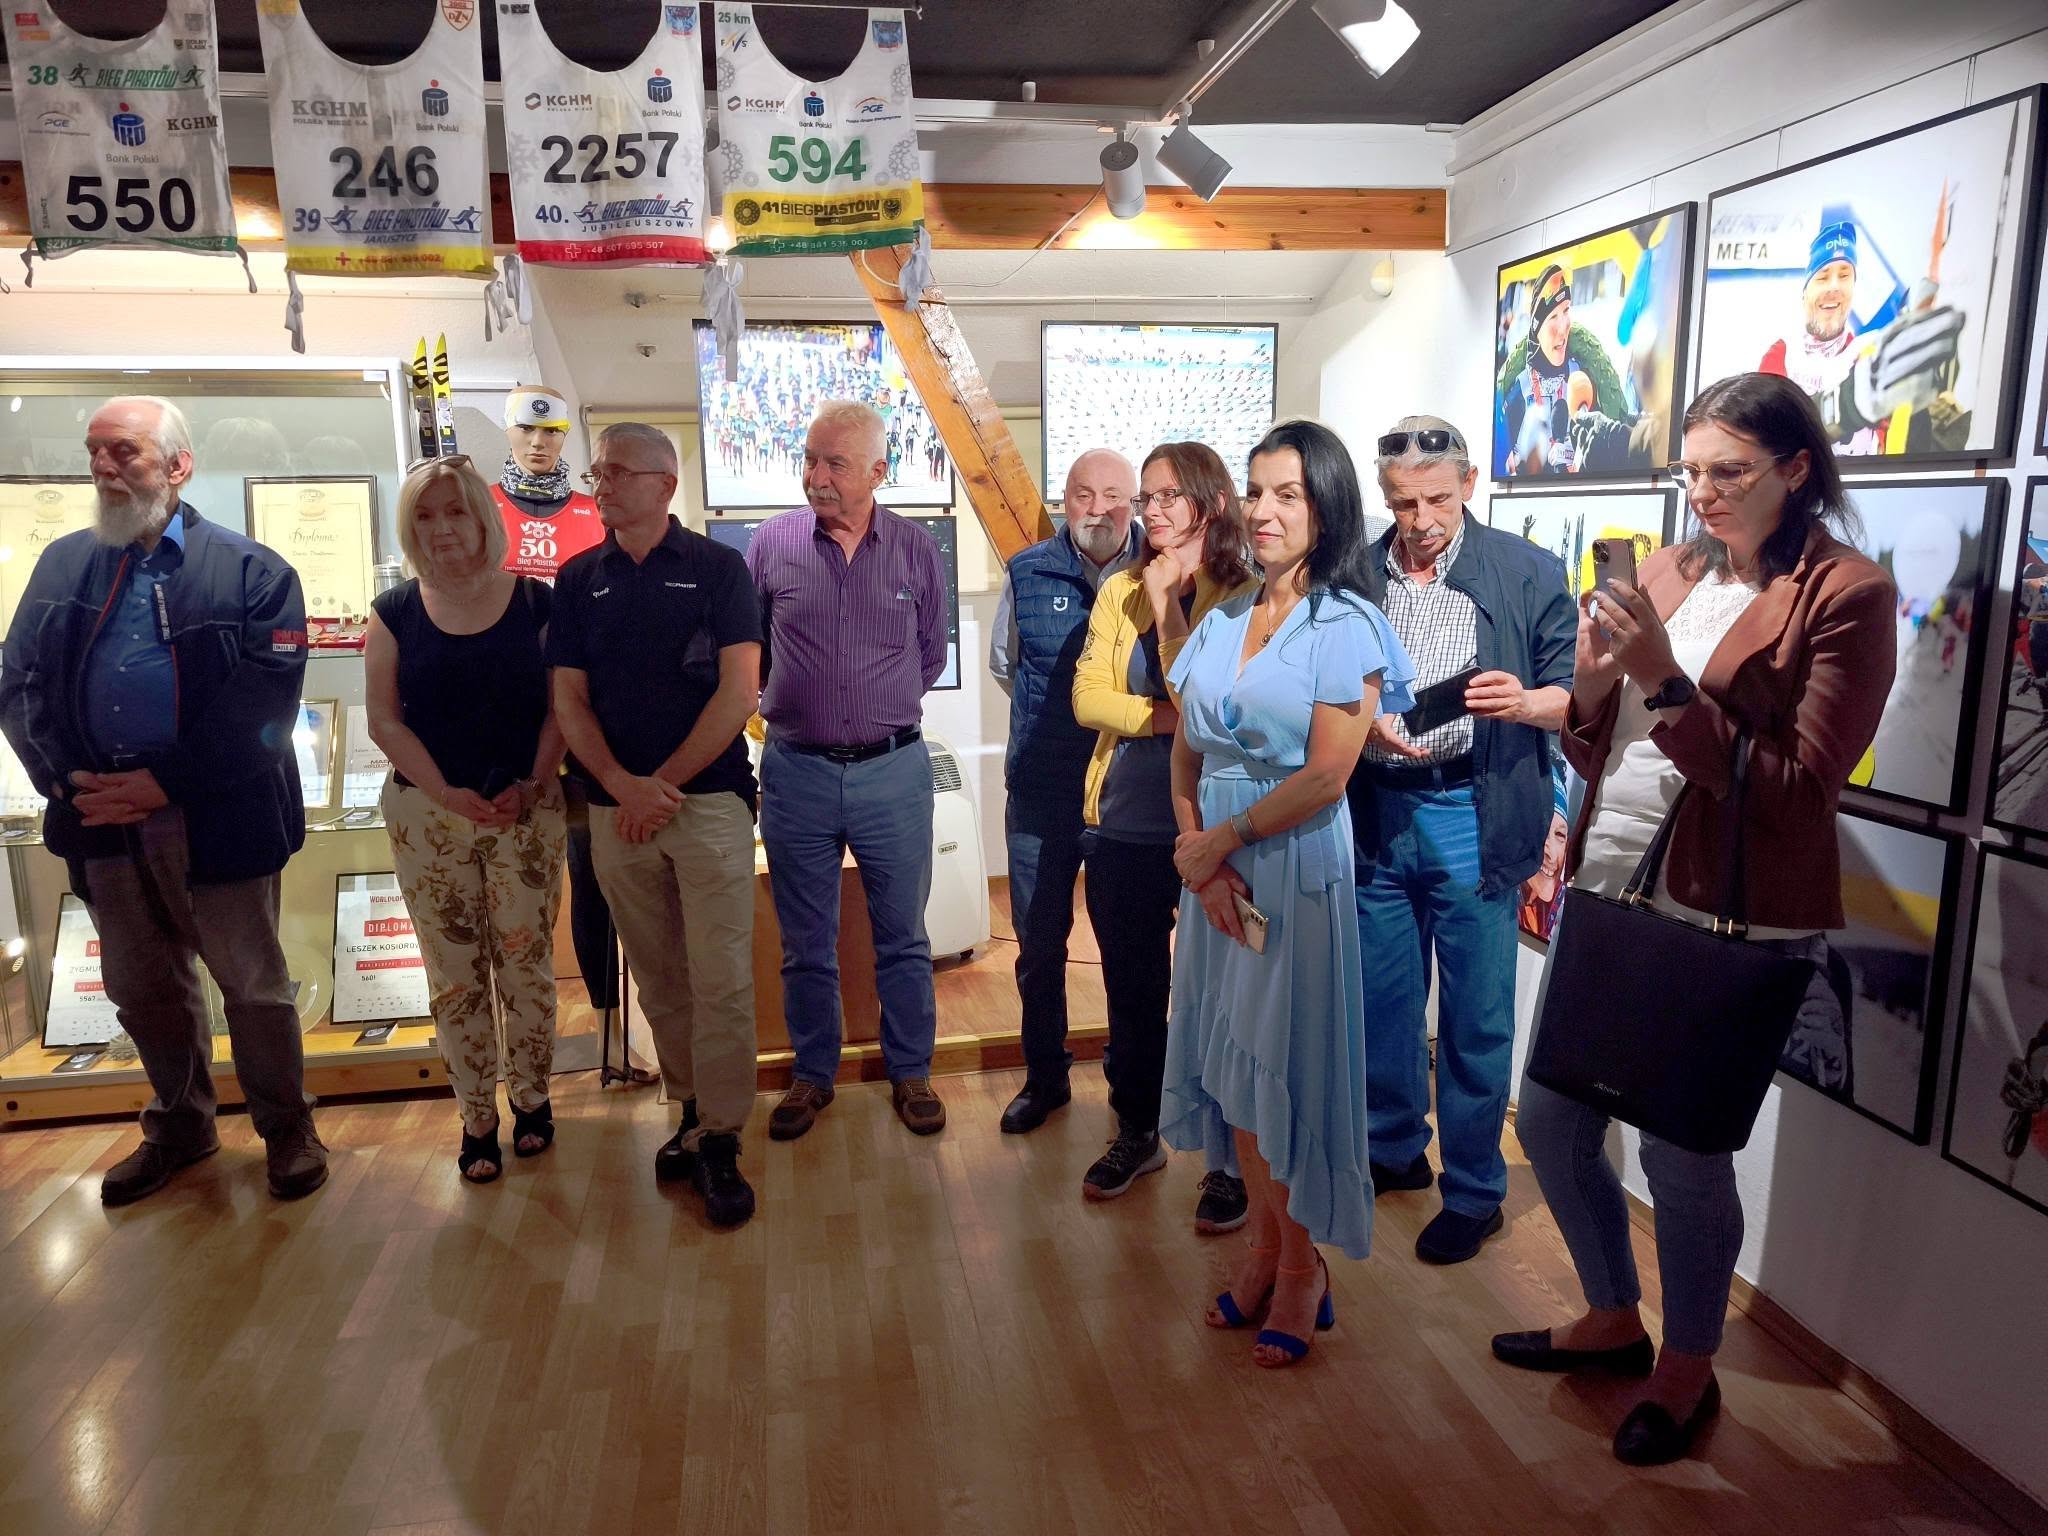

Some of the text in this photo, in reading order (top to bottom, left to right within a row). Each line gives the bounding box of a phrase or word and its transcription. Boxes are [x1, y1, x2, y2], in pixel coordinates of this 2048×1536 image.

[718, 12, 751, 25] 25 km
[27, 65, 59, 86] 38
[95, 68, 124, 87] BIEG
[546, 93, 593, 106] KGHM
[745, 98, 785, 109] KGHM
[291, 99, 369, 118] KGHM
[641, 109, 683, 118] Bank Polski
[861, 103, 885, 114] PGE
[44, 118, 71, 128] PGE
[166, 115, 218, 131] KGHM
[415, 123, 460, 133] Bank Polski
[105, 153, 159, 164] Bank Polski
[541, 131, 679, 184] 2257
[767, 135, 867, 184] 594
[329, 145, 440, 198] 246
[66, 175, 196, 233] 550
[292, 207, 322, 232] 39
[362, 208, 395, 231] BIEG
[535, 204, 569, 225] 40.
[601, 201, 625, 220] BIEG
[581, 218, 695, 233] JUBILEUSZOWY
[362, 233, 418, 245] JAKUSZYCE
[645, 240, 665, 250] 507
[1716, 243, 1769, 261] META
[519, 537, 558, 559] 50
[517, 557, 532, 566] Bieg
[346, 943, 378, 953] LESZEK
